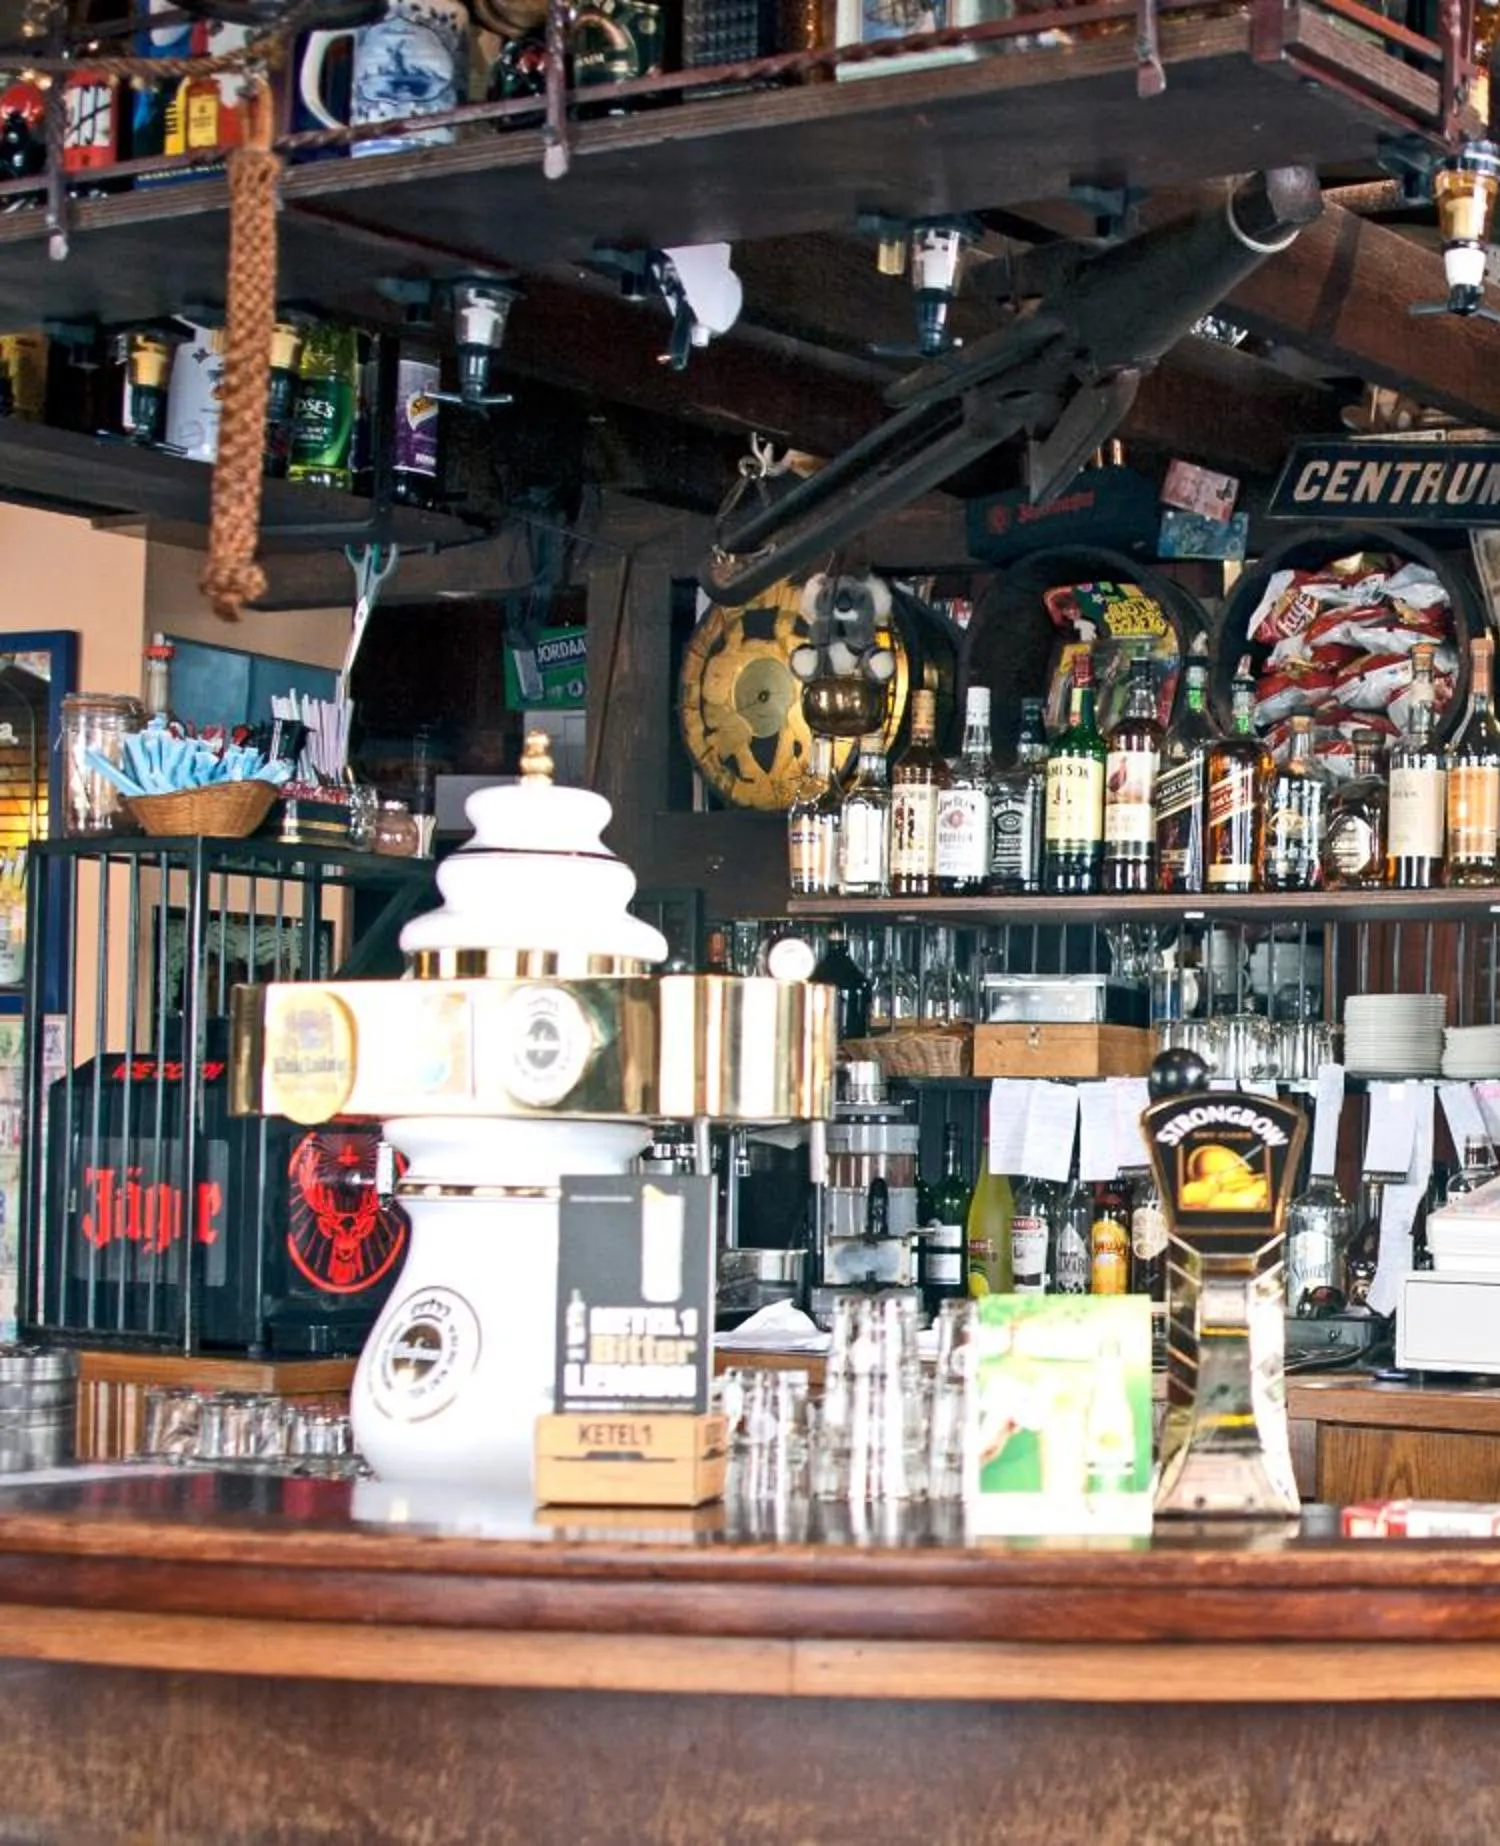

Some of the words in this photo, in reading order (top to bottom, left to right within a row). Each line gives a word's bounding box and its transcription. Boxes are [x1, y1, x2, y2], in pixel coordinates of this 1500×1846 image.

[537, 637, 587, 663] JORDAA
[1155, 1104, 1289, 1147] STRONGBOW
[590, 1336, 698, 1364] Bitter
[579, 1424, 653, 1446] KETEL1
